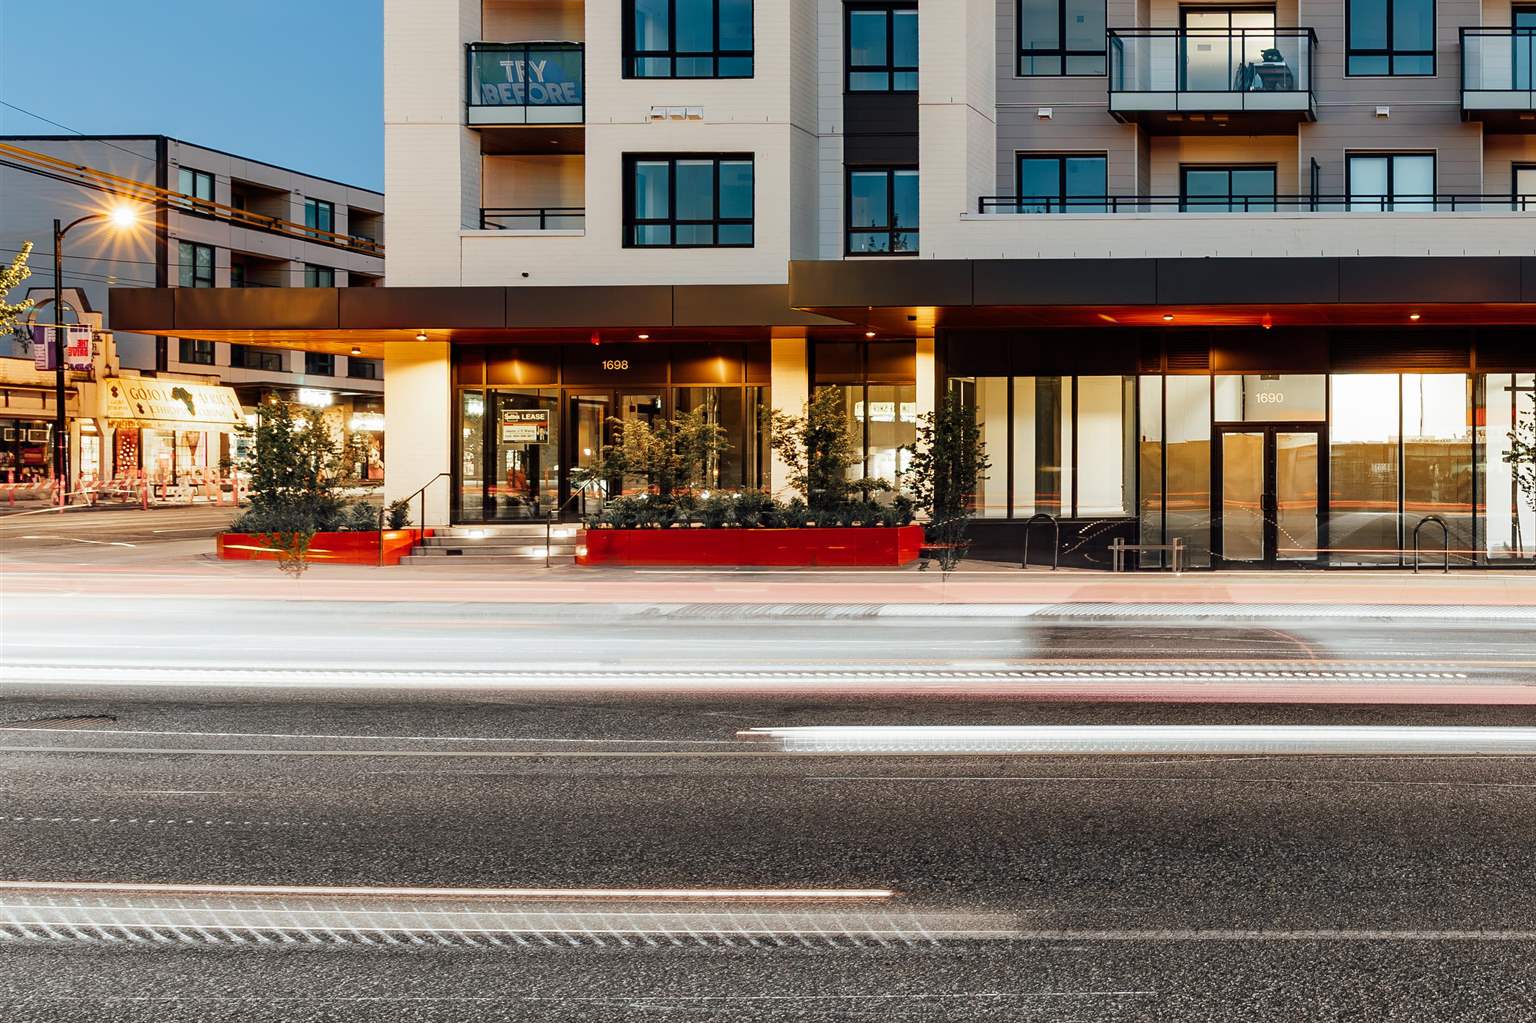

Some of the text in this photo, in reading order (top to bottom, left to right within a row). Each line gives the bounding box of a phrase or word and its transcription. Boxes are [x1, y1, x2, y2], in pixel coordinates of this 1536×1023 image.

[500, 60, 547, 82] TRY
[481, 82, 577, 105] BEFORE
[601, 359, 629, 370] 1698
[1256, 392, 1284, 403] 1690
